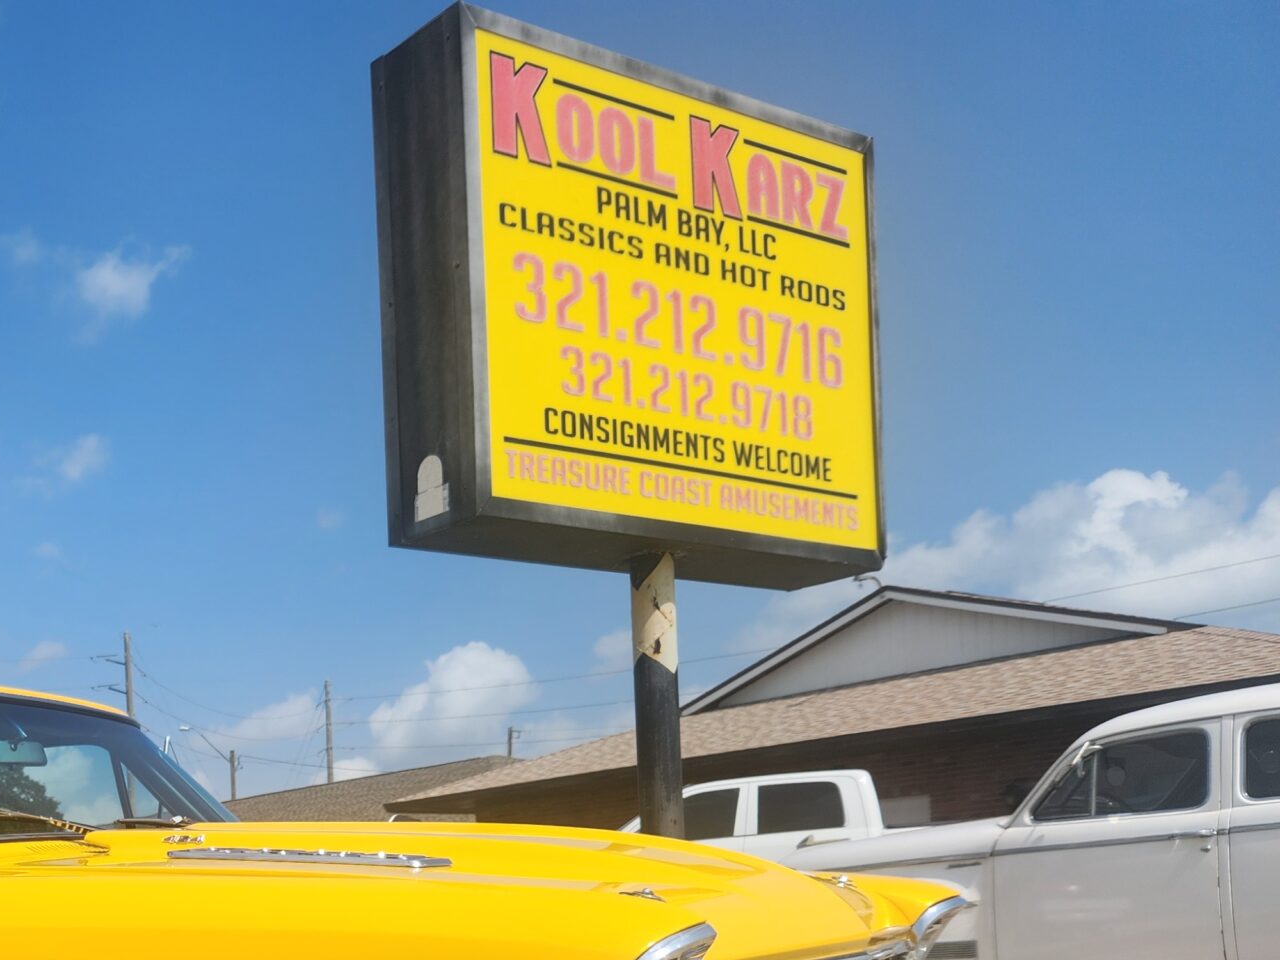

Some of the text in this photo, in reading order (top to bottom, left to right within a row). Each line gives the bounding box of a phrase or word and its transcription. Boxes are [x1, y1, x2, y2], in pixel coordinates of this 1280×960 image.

[489, 50, 848, 239] KOOL KARZ
[499, 202, 846, 311] CLASSICS AND HOT RODS
[597, 186, 777, 260] PALM BAY, LLC
[513, 252, 843, 389] 321.212.9716
[560, 345, 813, 441] 321.212.9718
[504, 449, 859, 531] TREASURE COAST AMUSEMENTS
[544, 407, 832, 482] CONSIGNMENTS WELCOME
